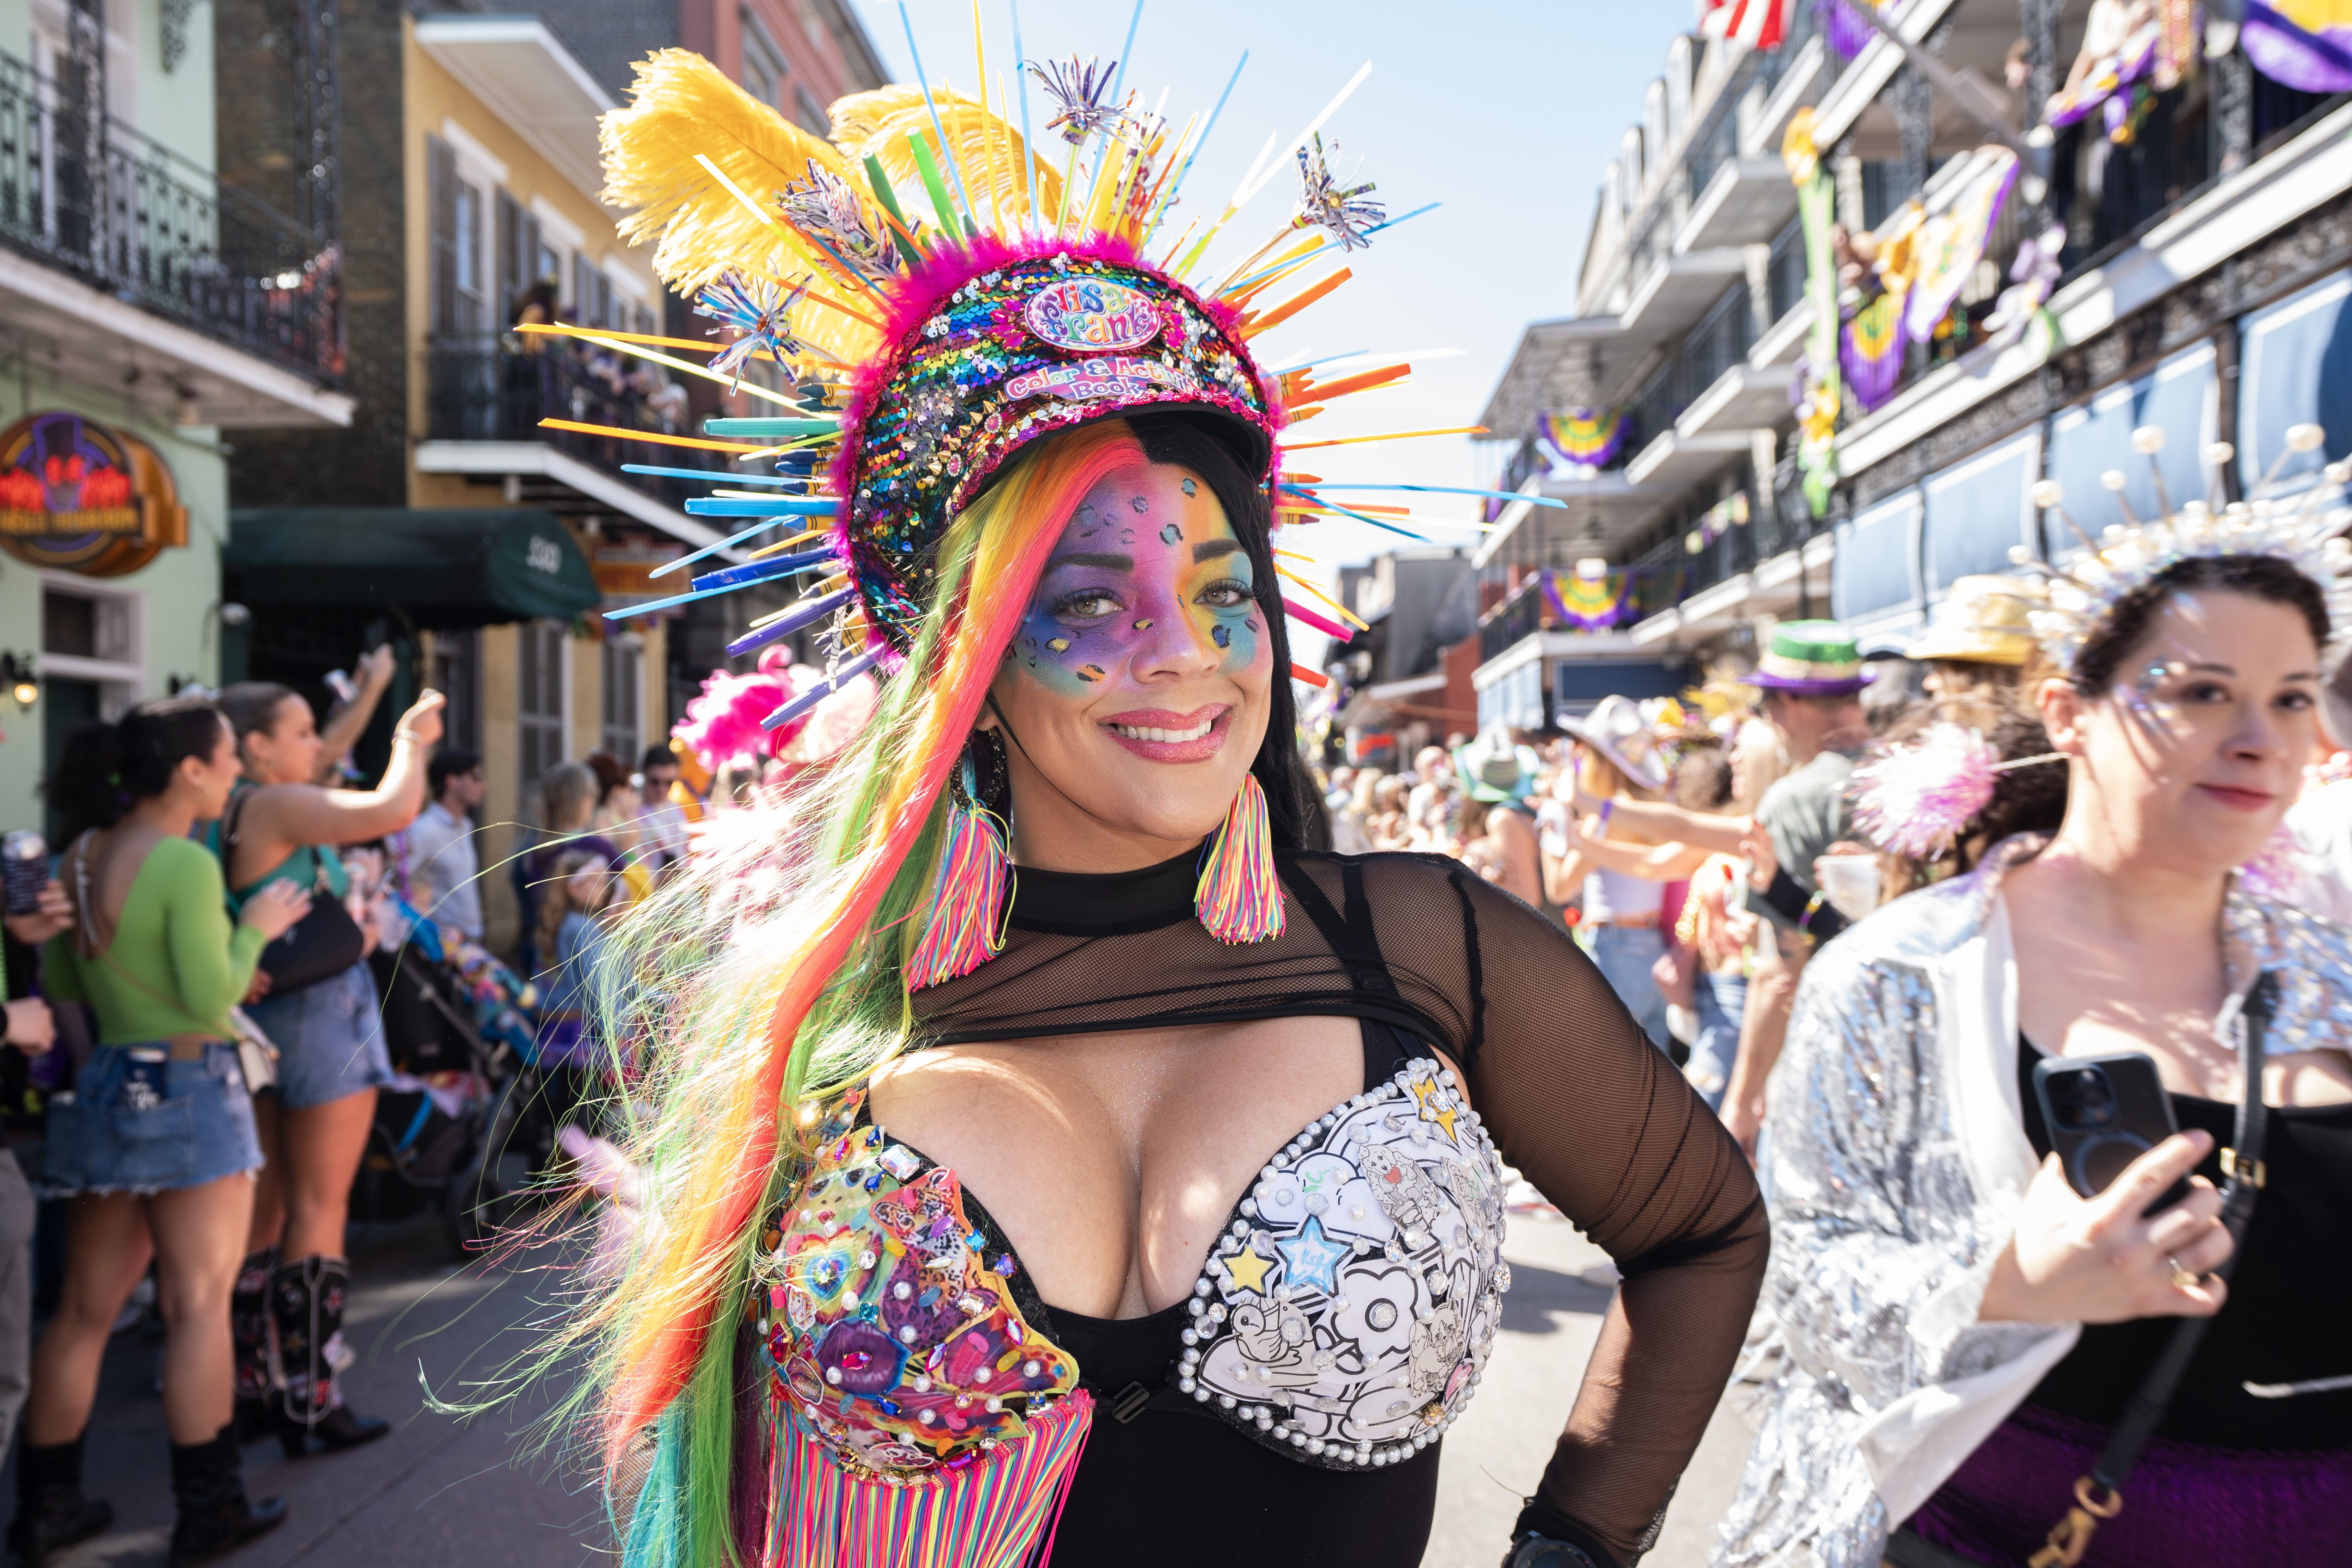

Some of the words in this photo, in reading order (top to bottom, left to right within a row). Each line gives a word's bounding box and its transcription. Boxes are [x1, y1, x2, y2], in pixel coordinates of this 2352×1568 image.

[1052, 283, 1128, 314] lisa
[1040, 301, 1150, 344] frank
[1006, 366, 1080, 399] Color
[1083, 358, 1113, 376] &
[1115, 357, 1194, 393] Activit
[1069, 376, 1140, 399] Book
